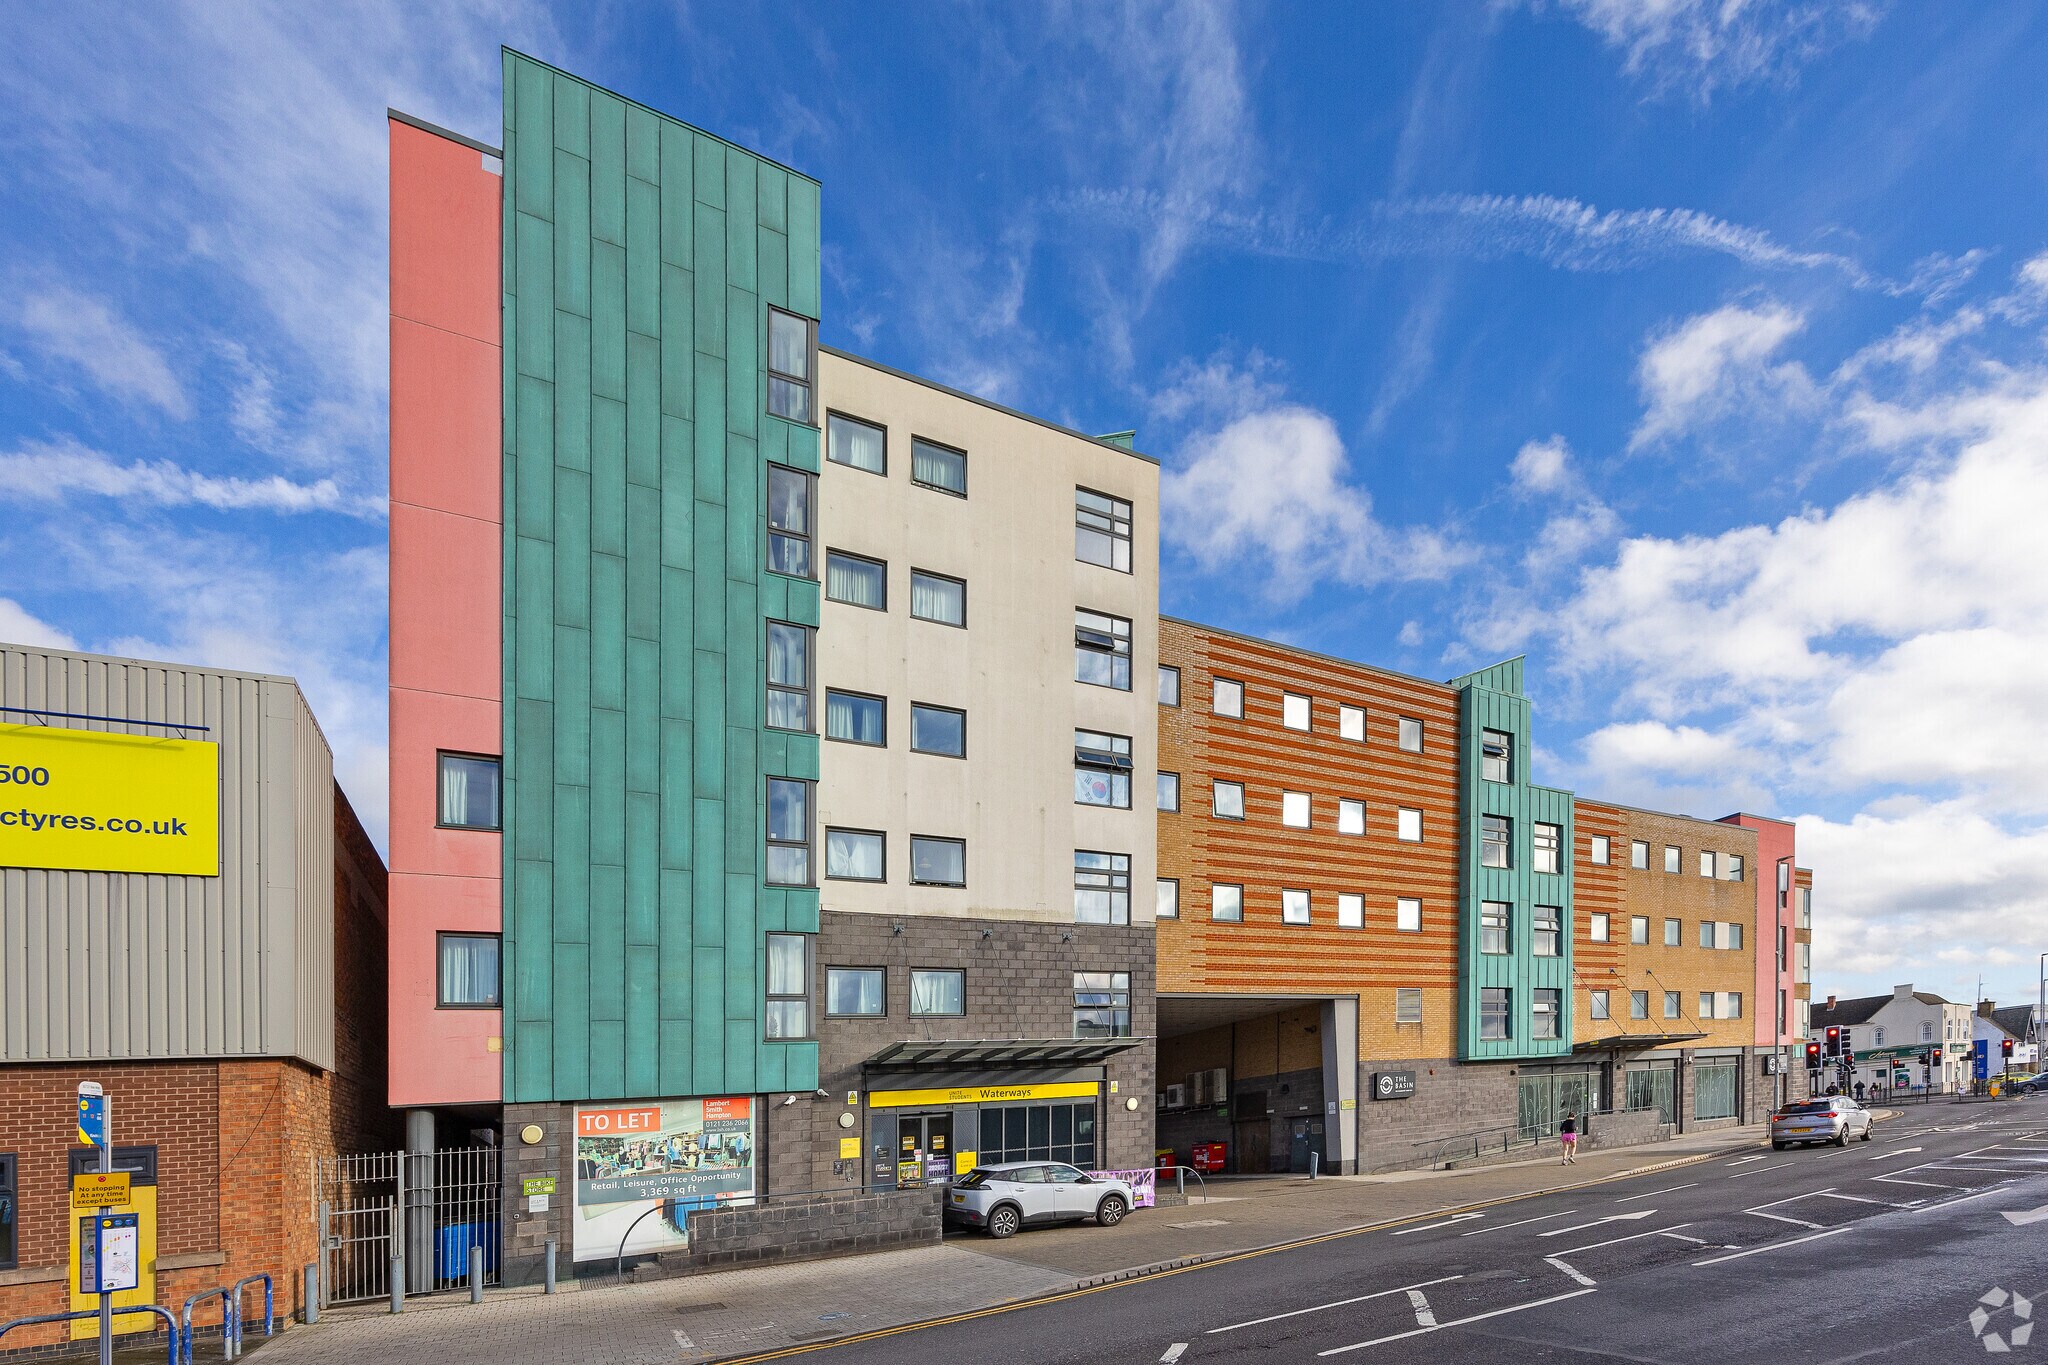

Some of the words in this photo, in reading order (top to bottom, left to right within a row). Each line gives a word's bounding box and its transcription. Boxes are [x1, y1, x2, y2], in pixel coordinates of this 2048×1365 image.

[0, 764, 50, 786] 500
[0, 808, 188, 836] ctyres.co.uk
[980, 1089, 1031, 1098] Waterways
[581, 1114, 610, 1131] TO
[617, 1112, 653, 1129] LET
[591, 1181, 620, 1191] Retail,
[623, 1178, 657, 1188] Leisure,
[660, 1176, 688, 1185] Office
[691, 1171, 742, 1183] Opportunity
[640, 1186, 669, 1198] 3,369
[673, 1187, 685, 1196] sq
[687, 1184, 697, 1193] ft
